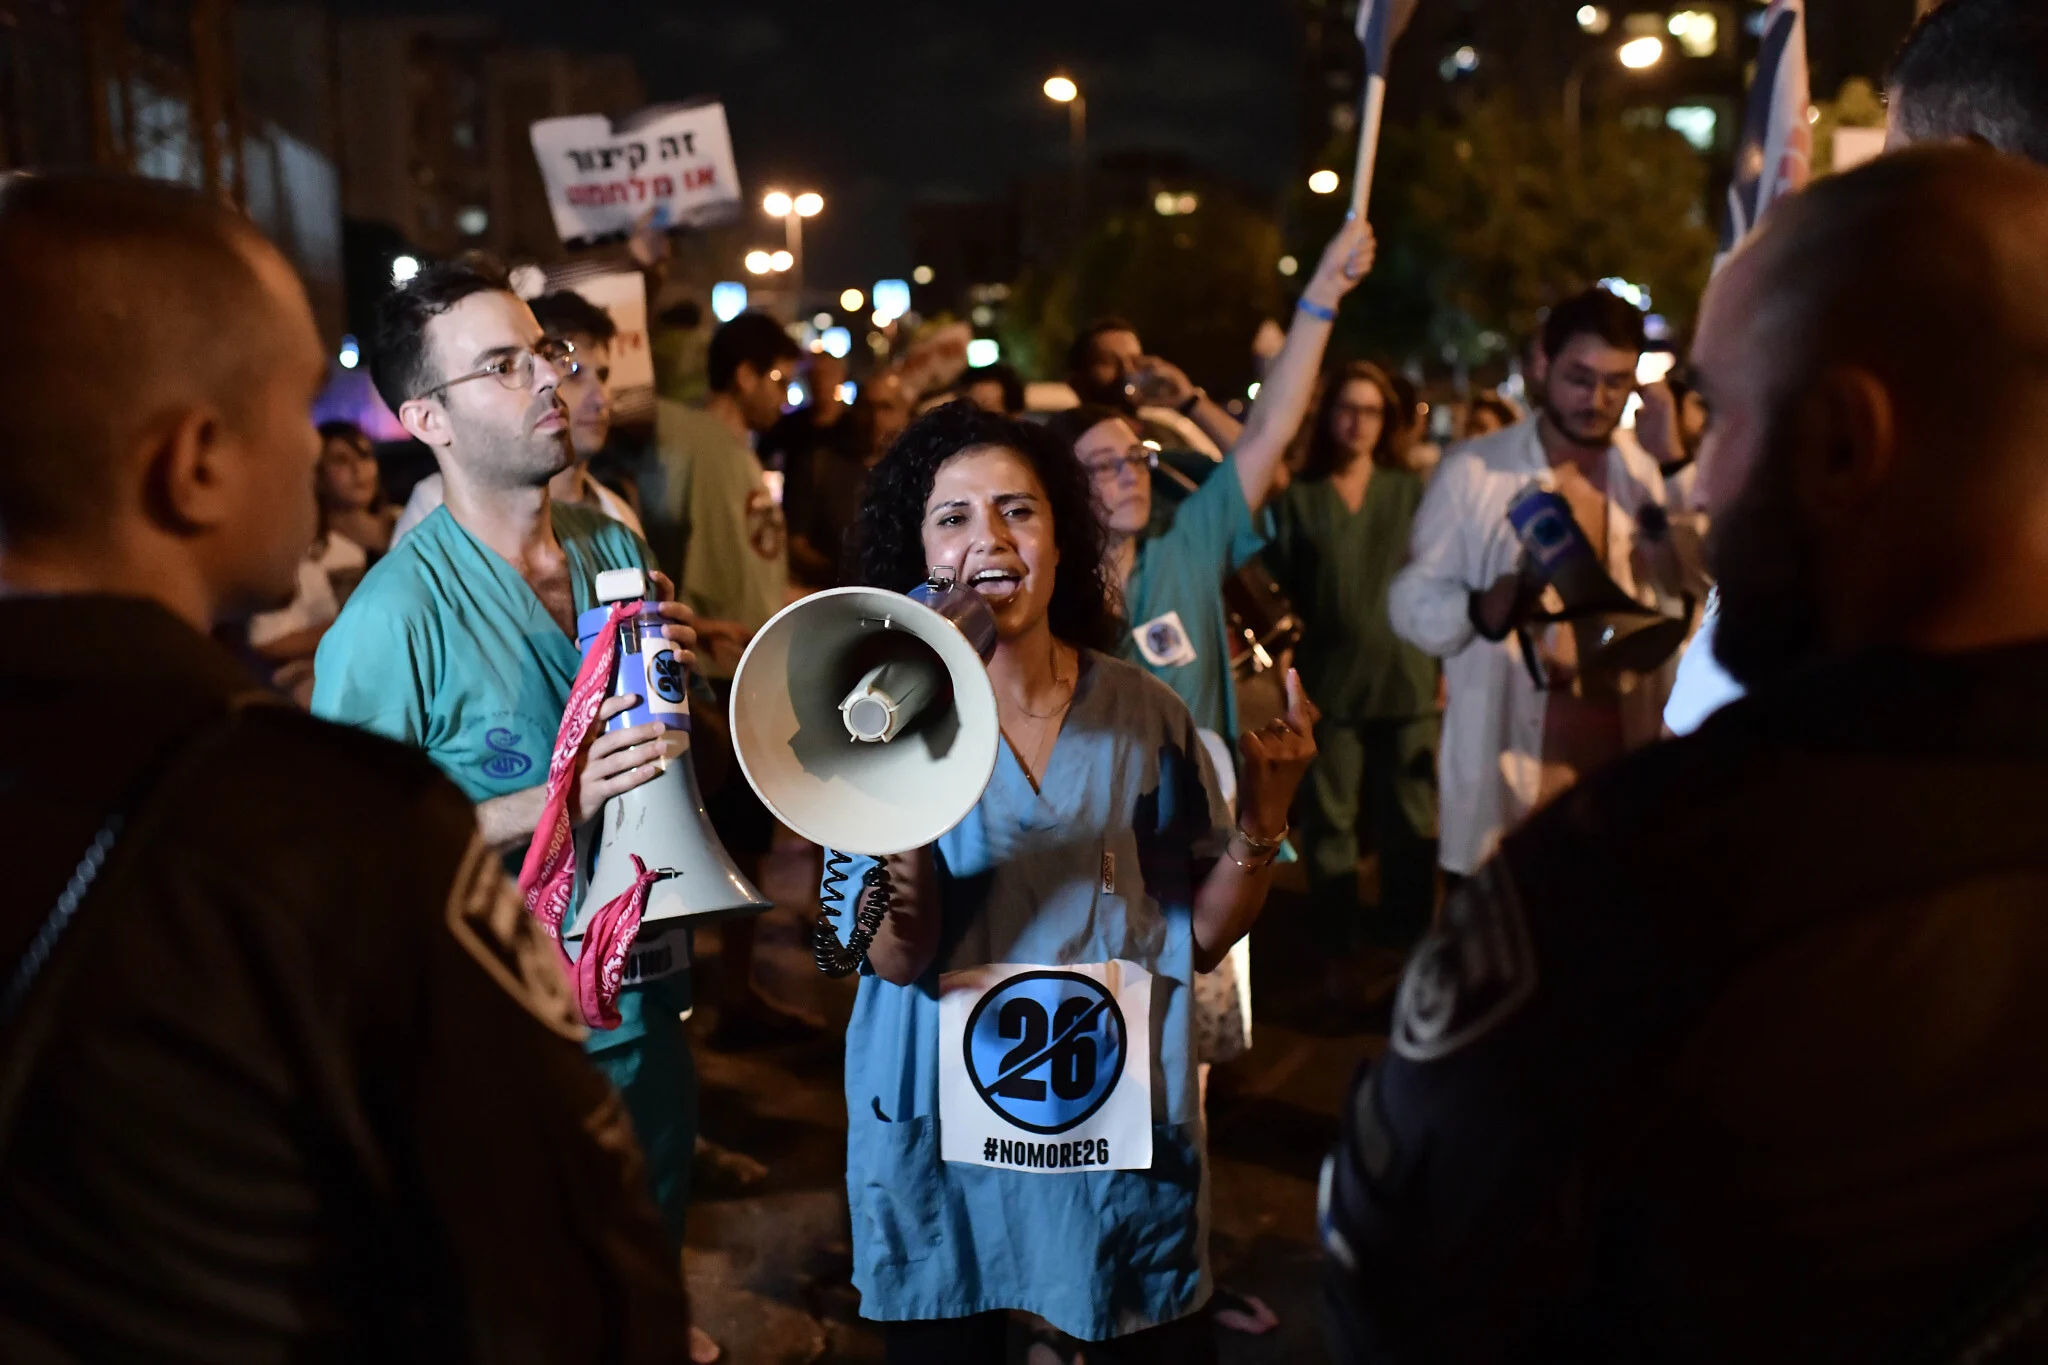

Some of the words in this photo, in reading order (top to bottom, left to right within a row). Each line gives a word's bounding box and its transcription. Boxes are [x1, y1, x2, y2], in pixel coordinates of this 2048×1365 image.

[565, 142, 647, 173] קיצור
[660, 132, 696, 160] זה
[683, 165, 716, 191] או
[998, 996, 1098, 1102] 26
[984, 1137, 1110, 1169] #NOMORE26
